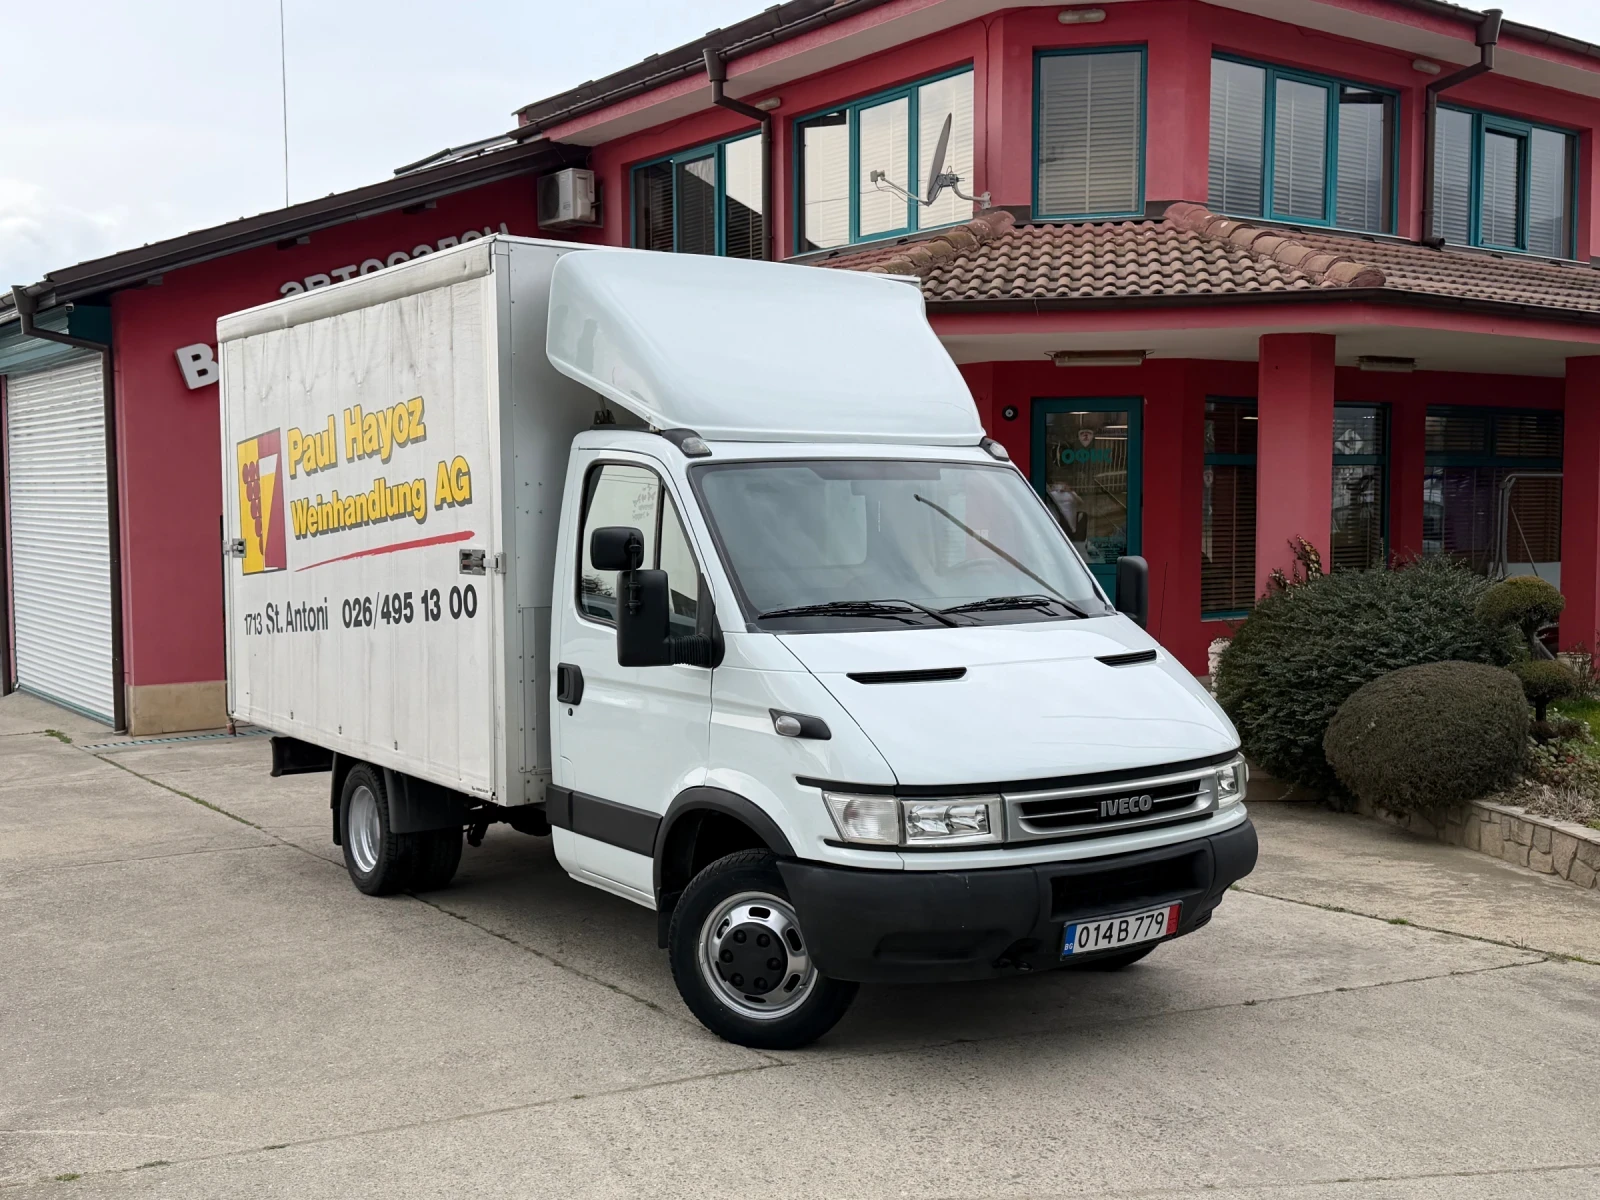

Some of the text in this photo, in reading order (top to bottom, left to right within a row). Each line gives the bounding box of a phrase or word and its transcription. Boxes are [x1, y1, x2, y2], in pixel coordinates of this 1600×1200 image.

[287, 396, 426, 479] Paul Hayoz
[290, 455, 473, 540] Weinhandlung AG
[244, 584, 477, 635] 1713 St. Antoni 026/495 13 00
[1100, 794, 1153, 817] IVECO
[1064, 943, 1074, 951] BG
